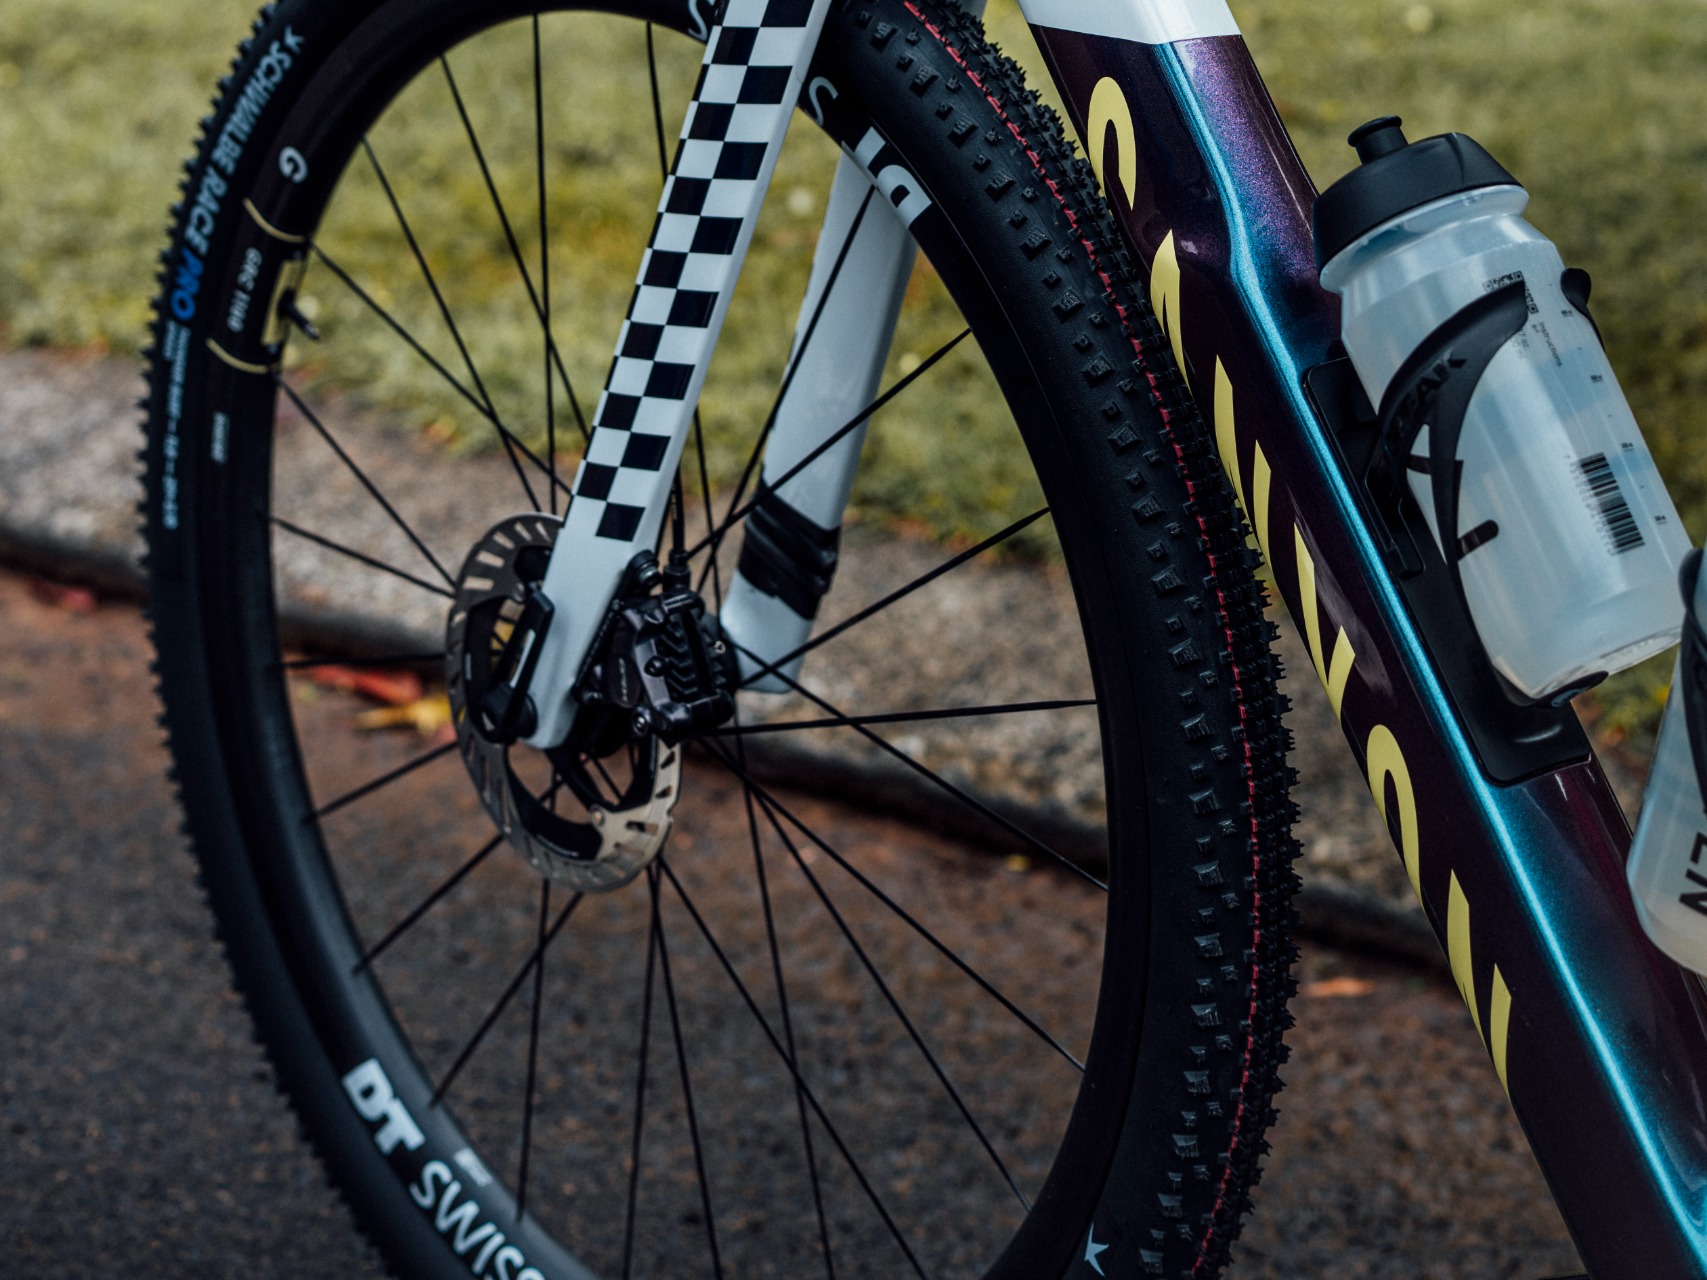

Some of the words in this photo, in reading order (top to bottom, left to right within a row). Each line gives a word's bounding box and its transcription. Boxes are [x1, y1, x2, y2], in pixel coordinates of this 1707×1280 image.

[212, 41, 293, 174] SCHWALBE
[186, 170, 228, 255] RACE
[171, 249, 204, 320] PRO
[342, 1058, 425, 1154] DT
[409, 1160, 546, 1280] SWIS
